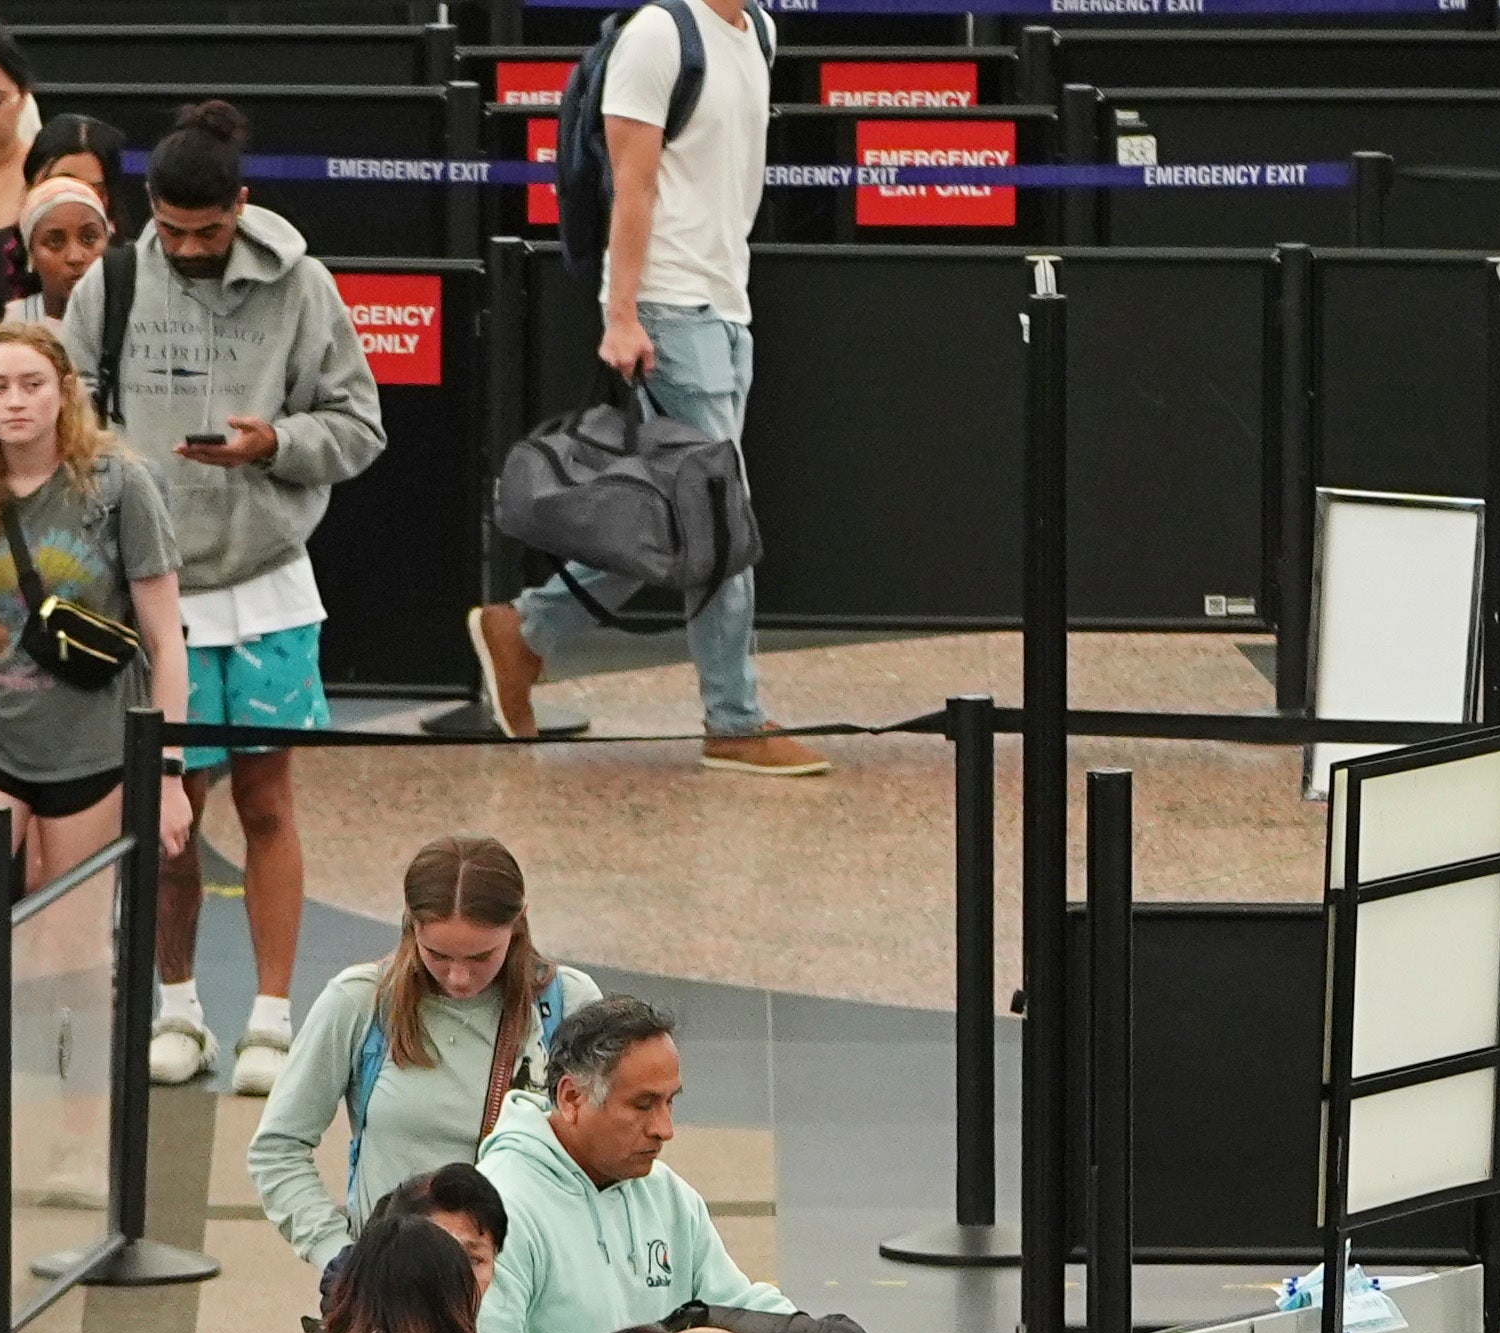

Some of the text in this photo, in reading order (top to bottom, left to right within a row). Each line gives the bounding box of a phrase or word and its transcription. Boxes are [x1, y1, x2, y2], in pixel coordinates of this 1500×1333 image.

[829, 91, 971, 107] EMERGENCY
[864, 149, 1010, 167] EMERGENCY
[327, 157, 490, 181] EMERGENCY EXIT
[857, 167, 899, 186] EXIT
[1144, 165, 1308, 186] EMERGENCY EXIT
[350, 305, 435, 326] GENCY
[360, 333, 420, 354] ONLY
